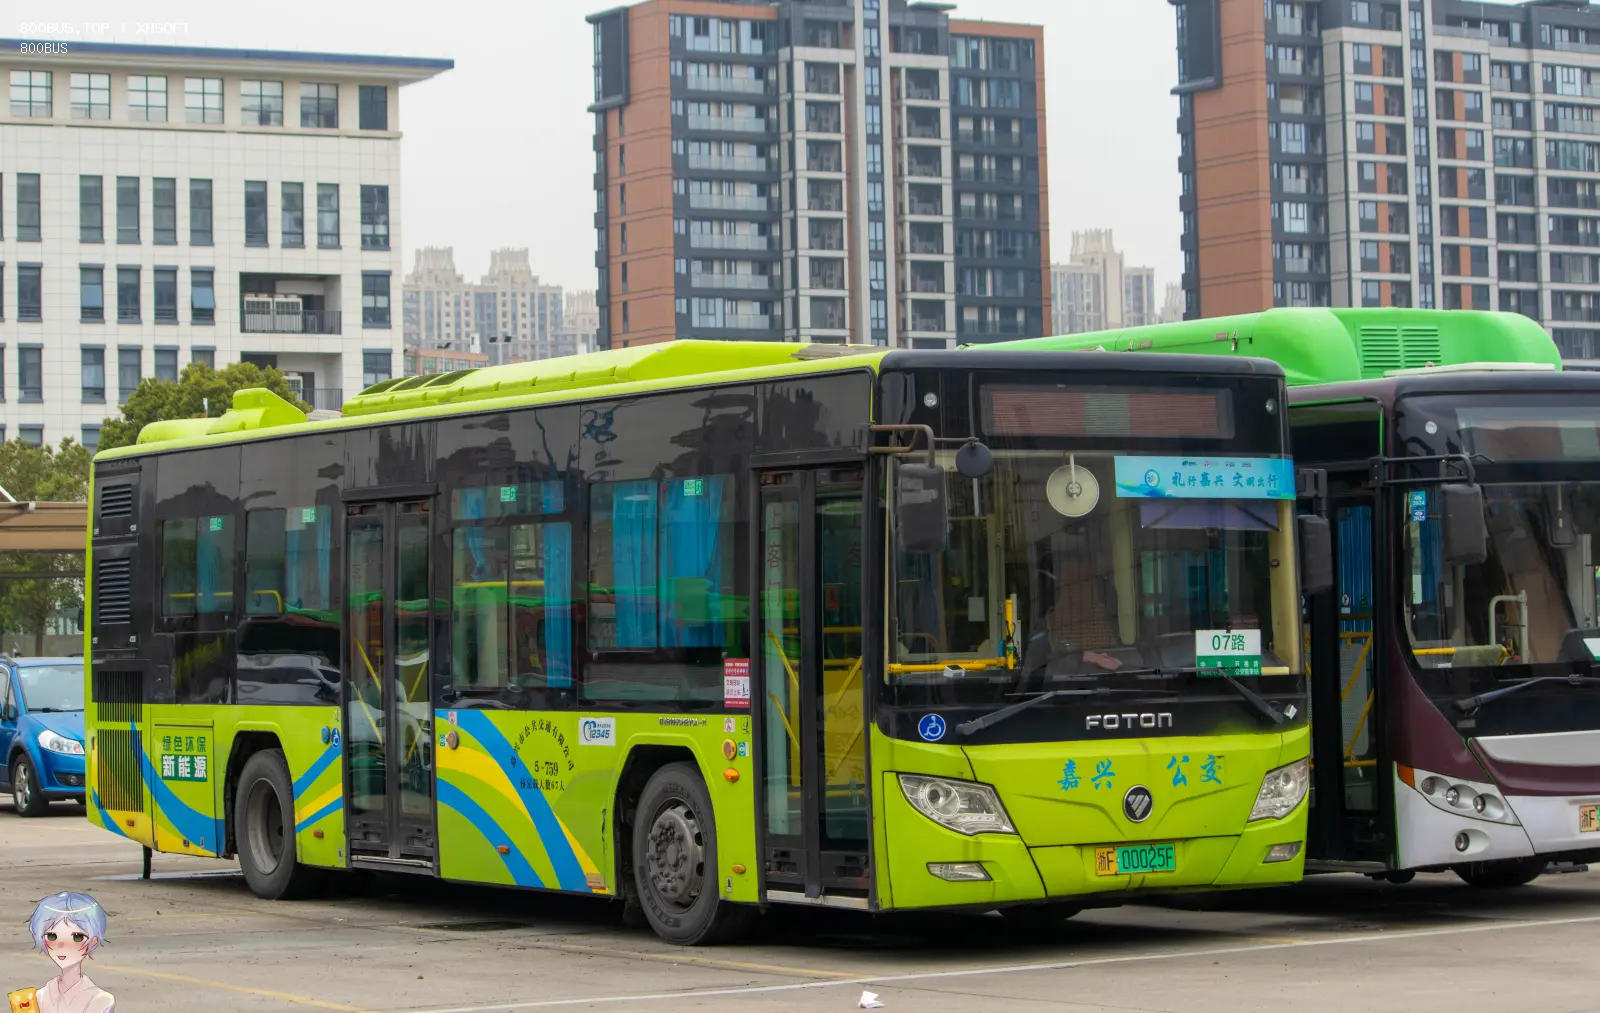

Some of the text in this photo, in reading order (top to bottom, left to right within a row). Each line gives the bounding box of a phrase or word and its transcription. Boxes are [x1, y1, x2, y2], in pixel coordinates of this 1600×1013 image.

[1212, 634, 1245, 651] 07路
[1086, 712, 1173, 731] FOTON
[589, 729, 610, 739] 12345
[162, 735, 207, 752] 绿色环保
[162, 755, 207, 778] 新能源
[534, 760, 559, 776] 5-759
[1057, 754, 1222, 791] 嘉兴 公交
[1121, 847, 1173, 870] 00025F
